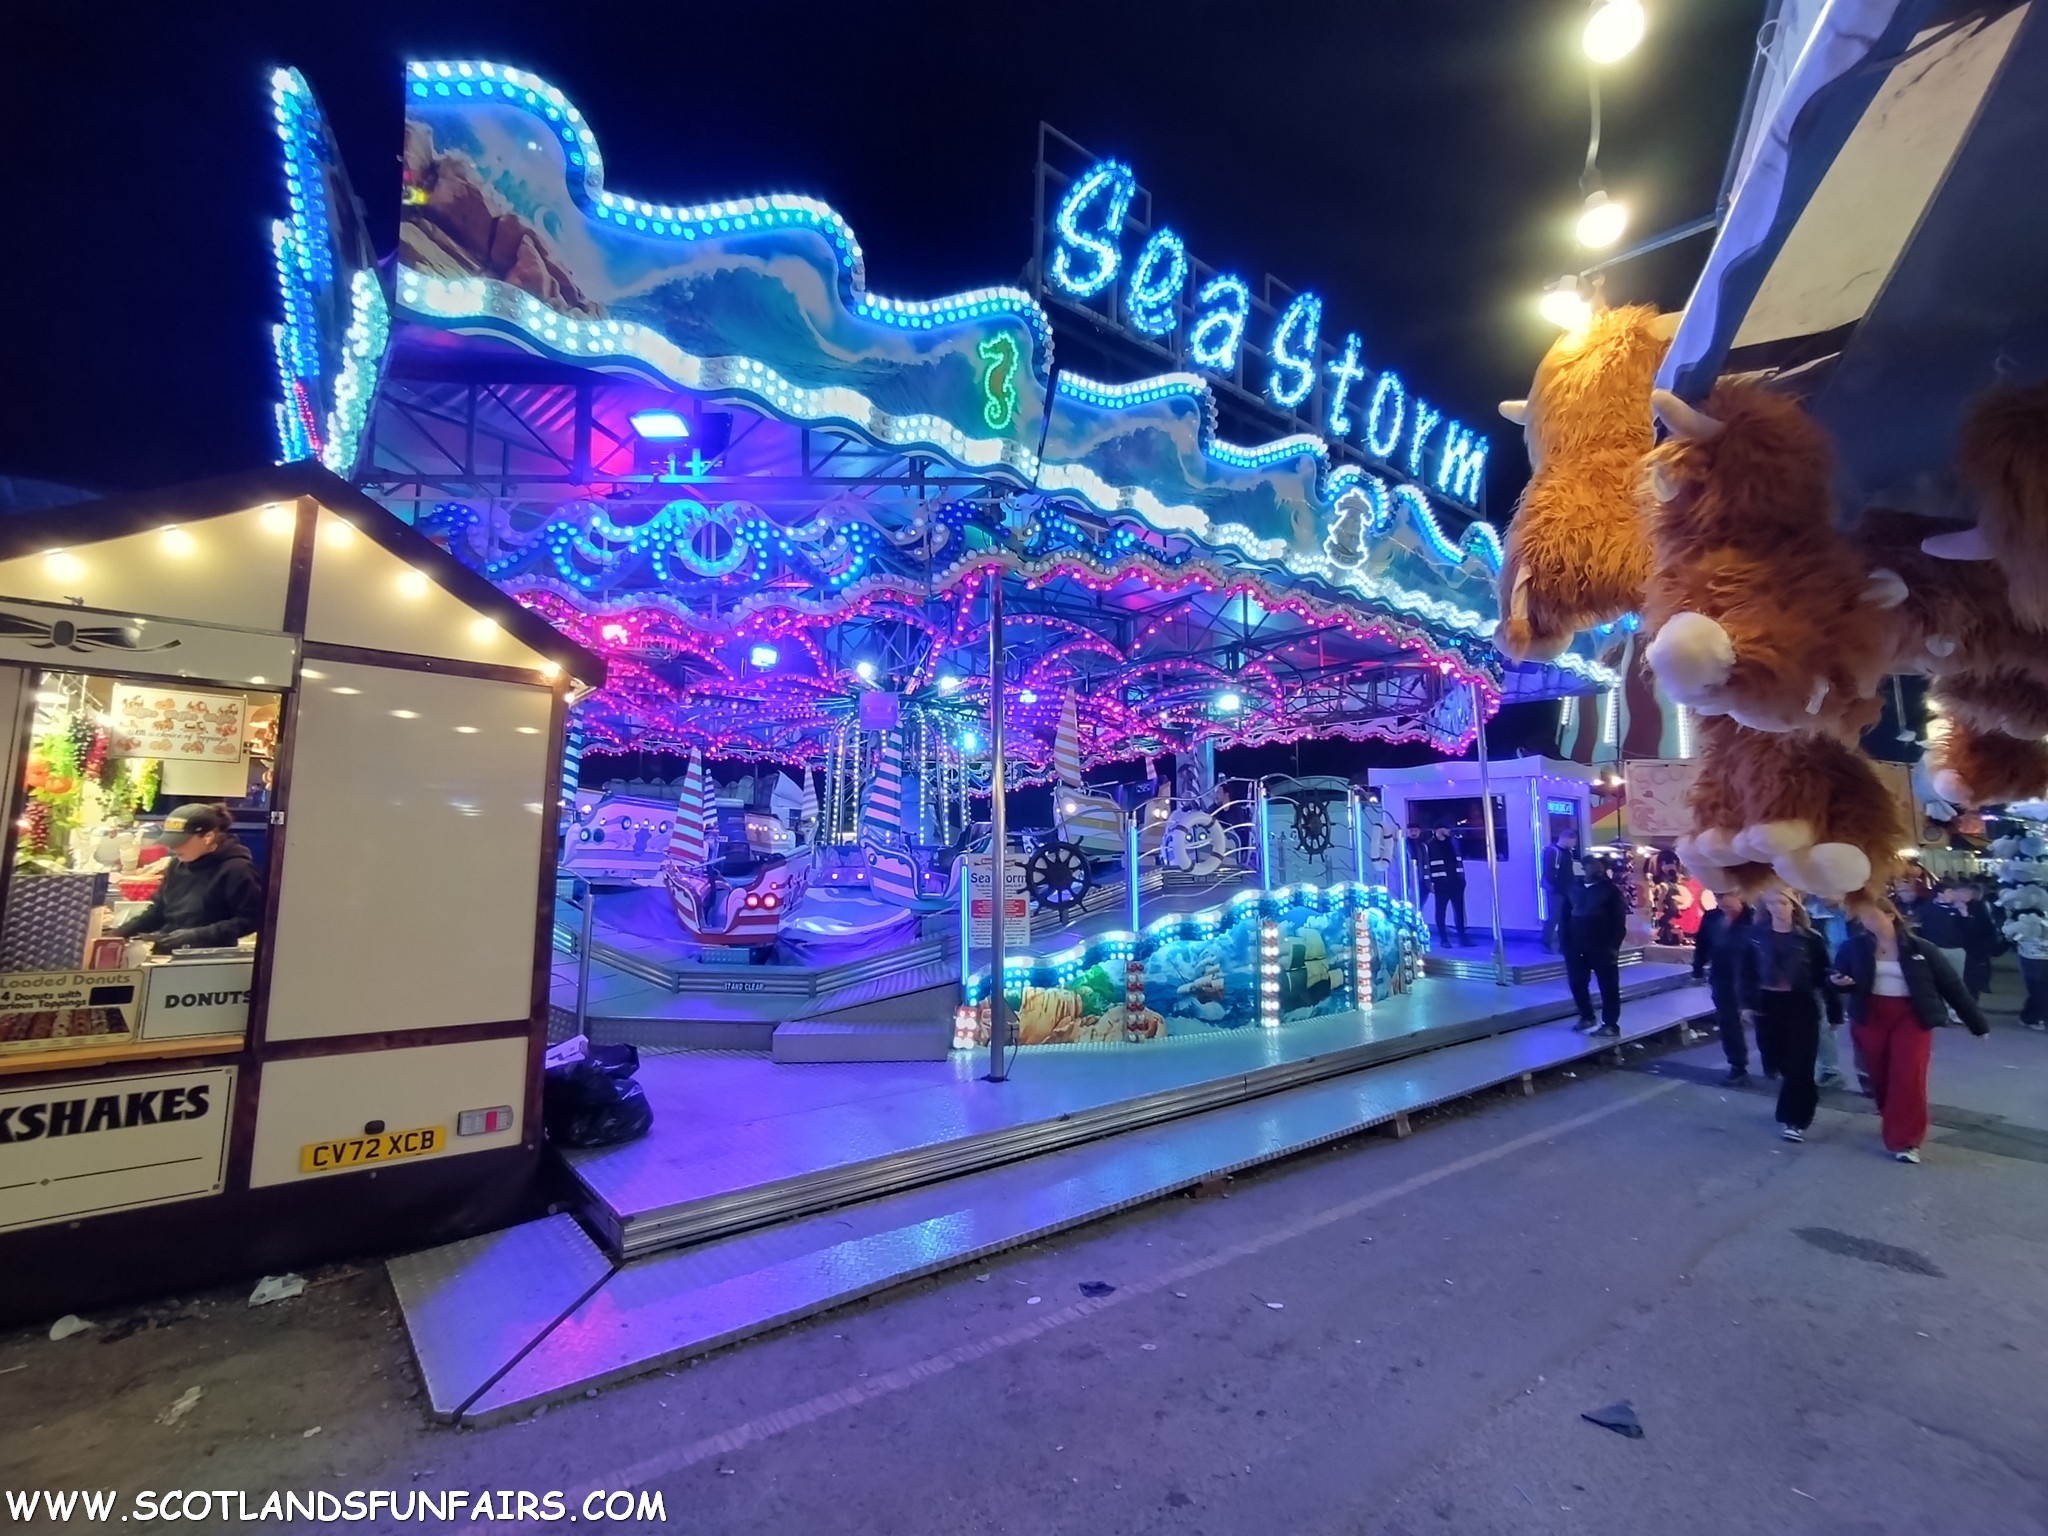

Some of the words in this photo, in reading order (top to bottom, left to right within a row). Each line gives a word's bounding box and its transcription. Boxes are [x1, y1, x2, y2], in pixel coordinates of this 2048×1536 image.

[970, 873, 991, 883] Sea
[0, 975, 67, 989] Loaded
[73, 974, 131, 986] Donuts
[724, 982, 743, 991] STAND
[744, 982, 764, 991] CLEAR
[1, 991, 10, 1000] 4
[14, 992, 54, 1001] Donuts
[57, 990, 82, 999] with
[164, 990, 251, 1009] DONUTS
[38, 999, 87, 1010] Toppings
[313, 1138, 381, 1166] CV72
[388, 1130, 435, 1155] XCB
